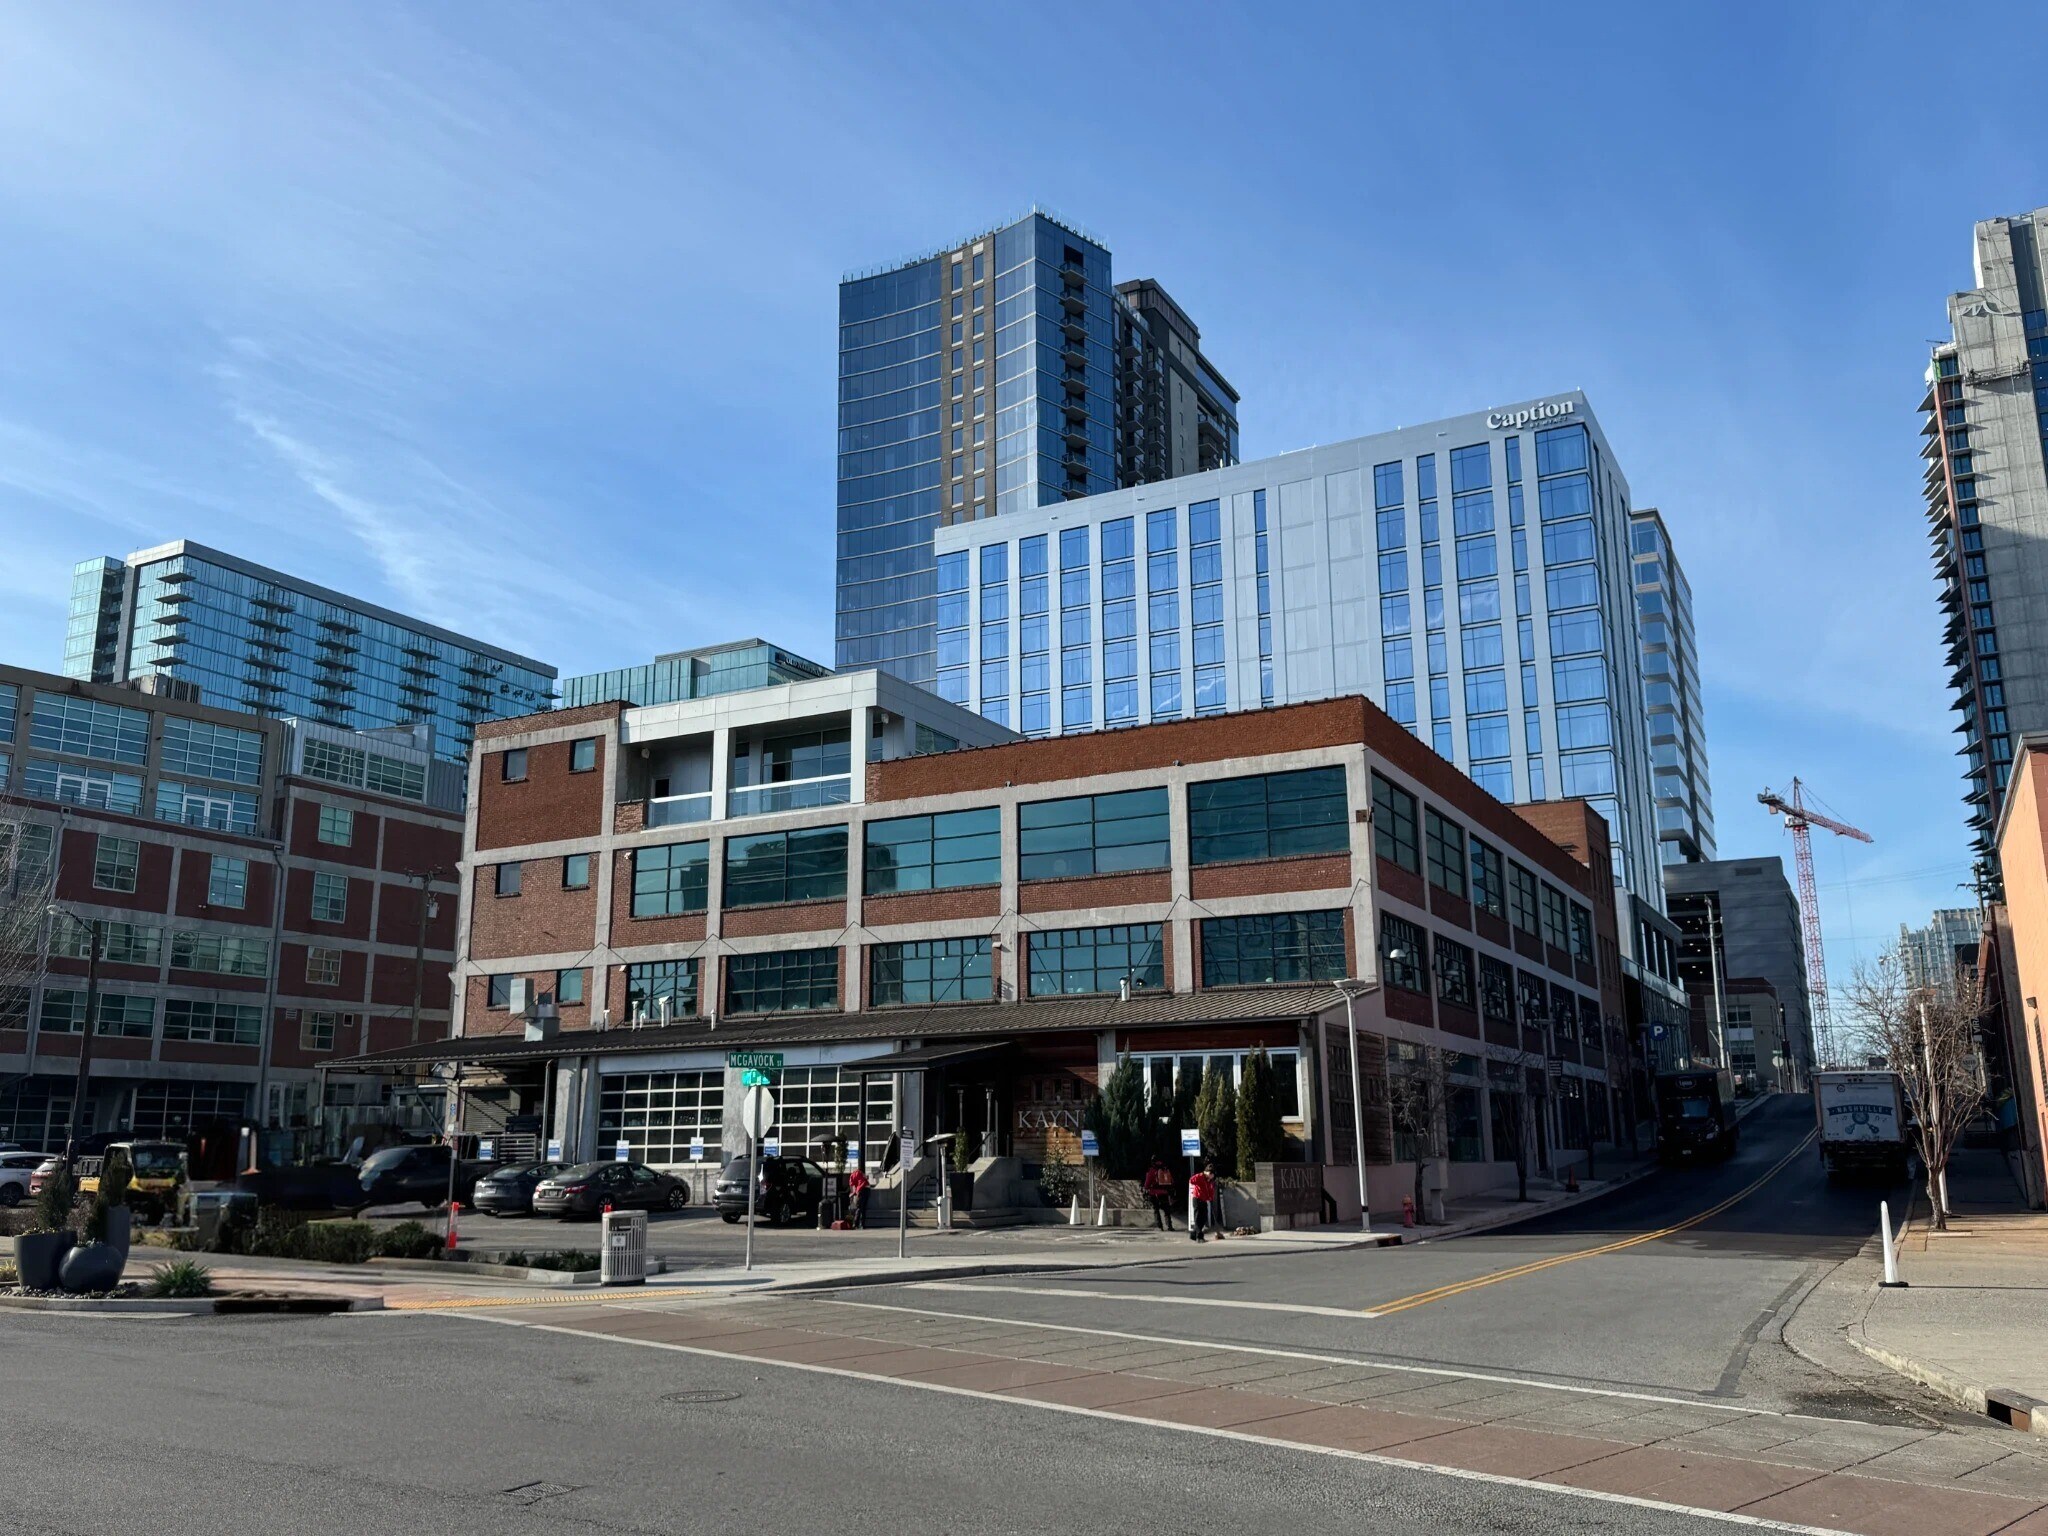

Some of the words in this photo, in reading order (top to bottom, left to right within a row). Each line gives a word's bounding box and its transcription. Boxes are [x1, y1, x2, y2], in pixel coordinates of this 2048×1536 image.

[1486, 400, 1575, 430] Caption
[1653, 1025, 1664, 1036] P
[730, 1054, 775, 1067] MCGAVOCK
[1837, 1104, 1883, 1113] NASHVILLE
[1018, 1109, 1085, 1128] KAYN
[1280, 1167, 1316, 1189] KAYNE
